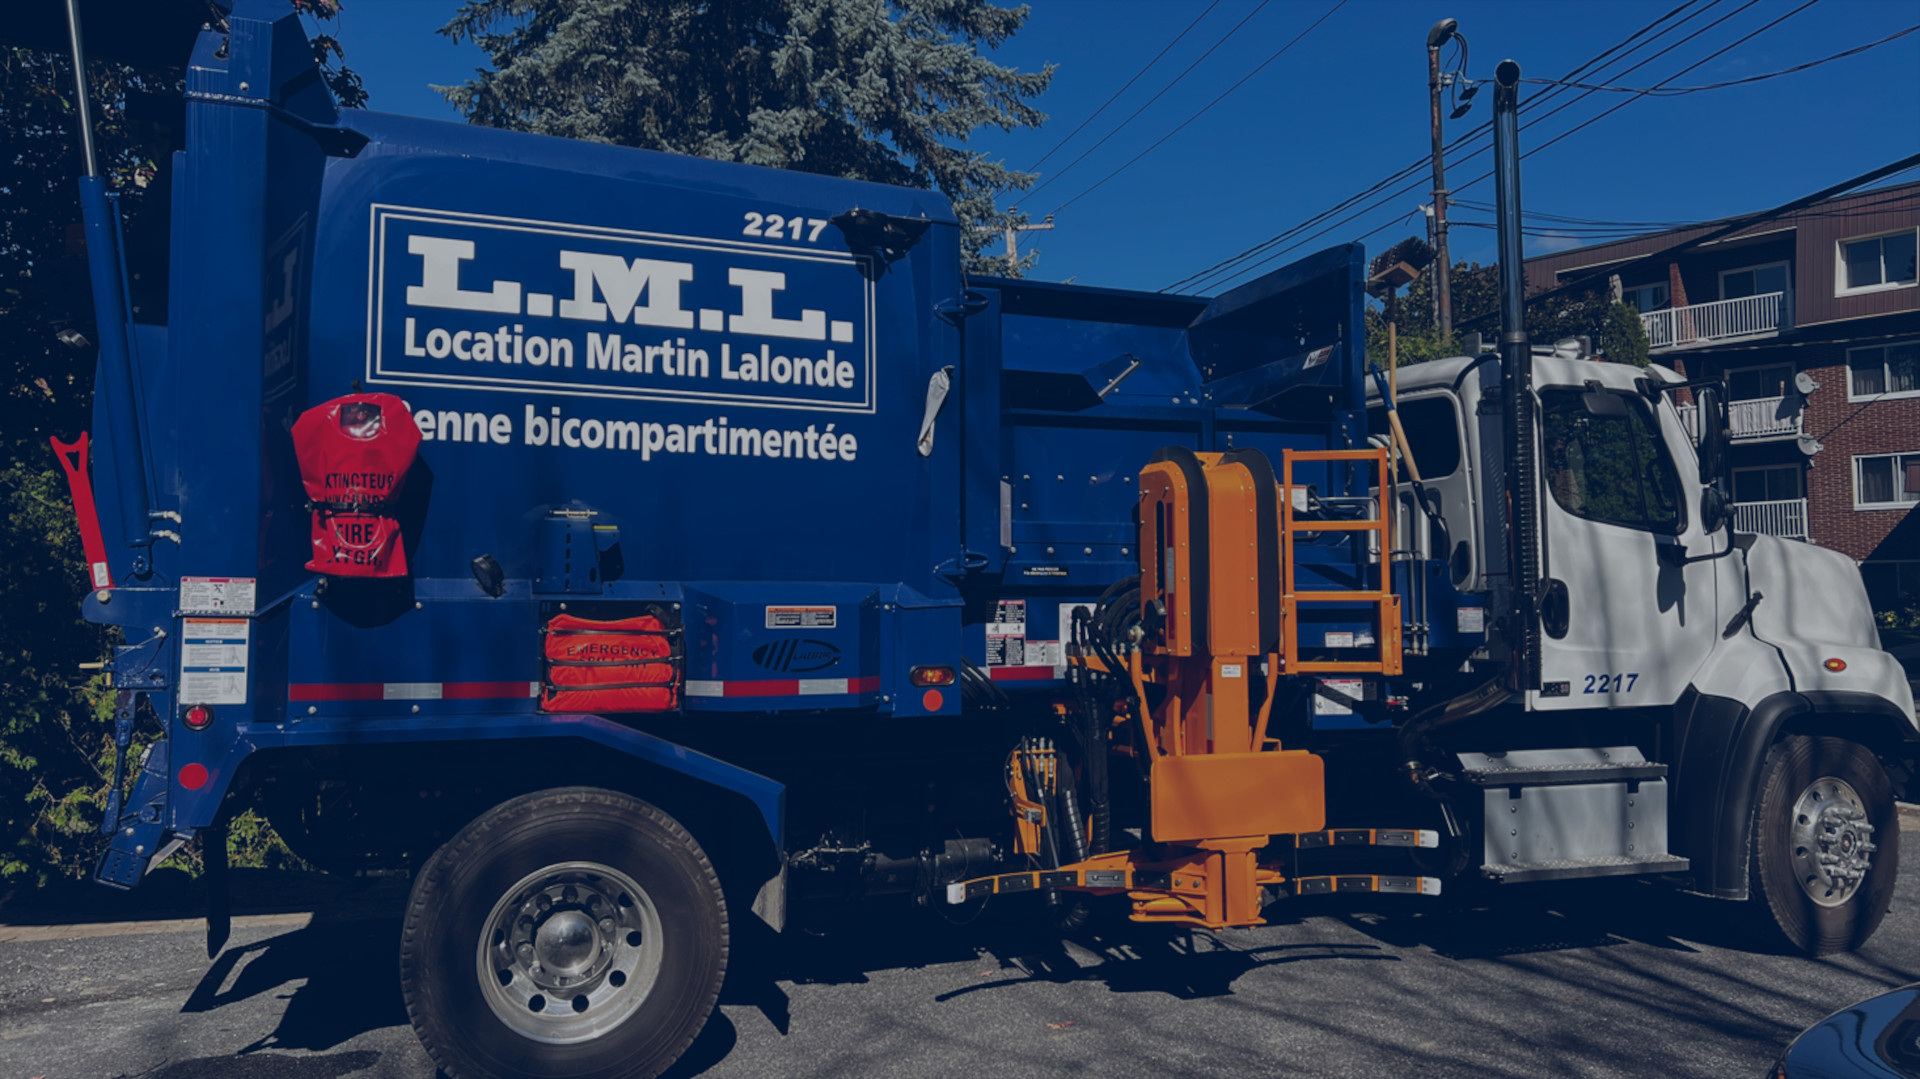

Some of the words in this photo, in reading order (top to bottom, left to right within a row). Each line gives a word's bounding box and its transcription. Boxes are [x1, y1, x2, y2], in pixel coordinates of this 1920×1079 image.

[742, 211, 828, 242] 2217
[406, 234, 854, 343] L.M.L.
[404, 317, 574, 368] Location
[586, 331, 710, 378] Martin
[721, 343, 856, 389] Lalonde
[401, 399, 513, 444] enne
[524, 403, 858, 462] bicompartimentée
[335, 523, 375, 544] FIRE
[567, 643, 660, 658] EMERGENCY
[1583, 672, 1640, 695] 2217
